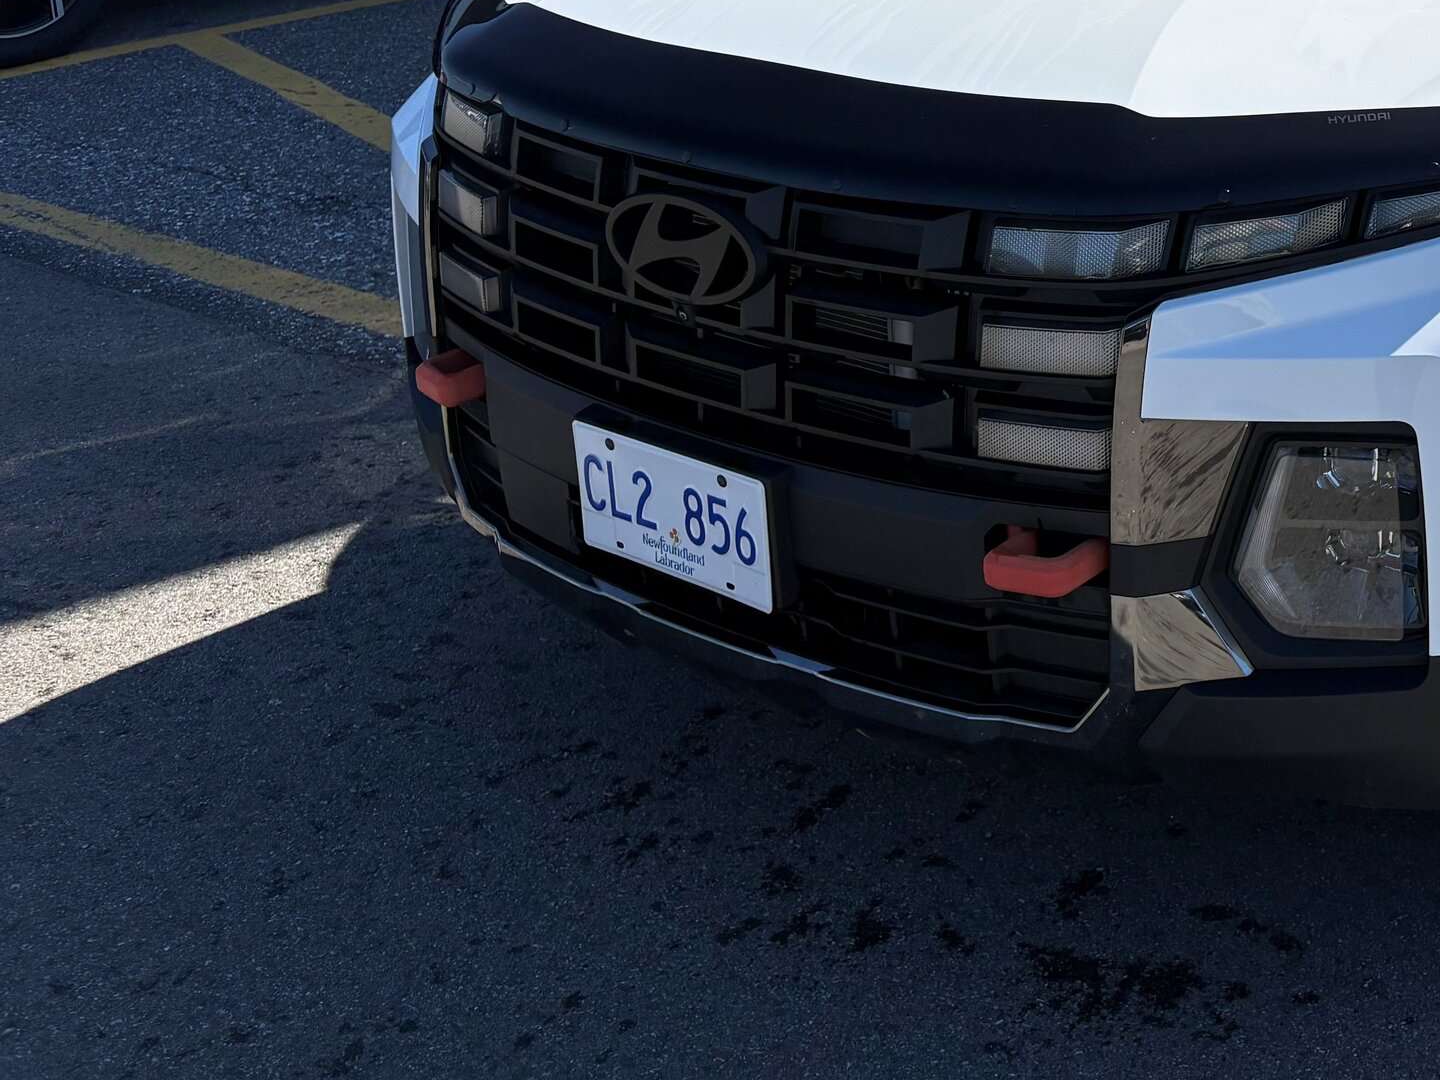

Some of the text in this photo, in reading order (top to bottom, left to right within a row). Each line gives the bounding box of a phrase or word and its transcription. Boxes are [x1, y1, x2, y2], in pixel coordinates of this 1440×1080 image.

[1327, 112, 1391, 124] HYUNDAI
[583, 453, 757, 567] CL2 856
[642, 531, 705, 567] Newfoundland
[655, 551, 695, 577] Labrador
